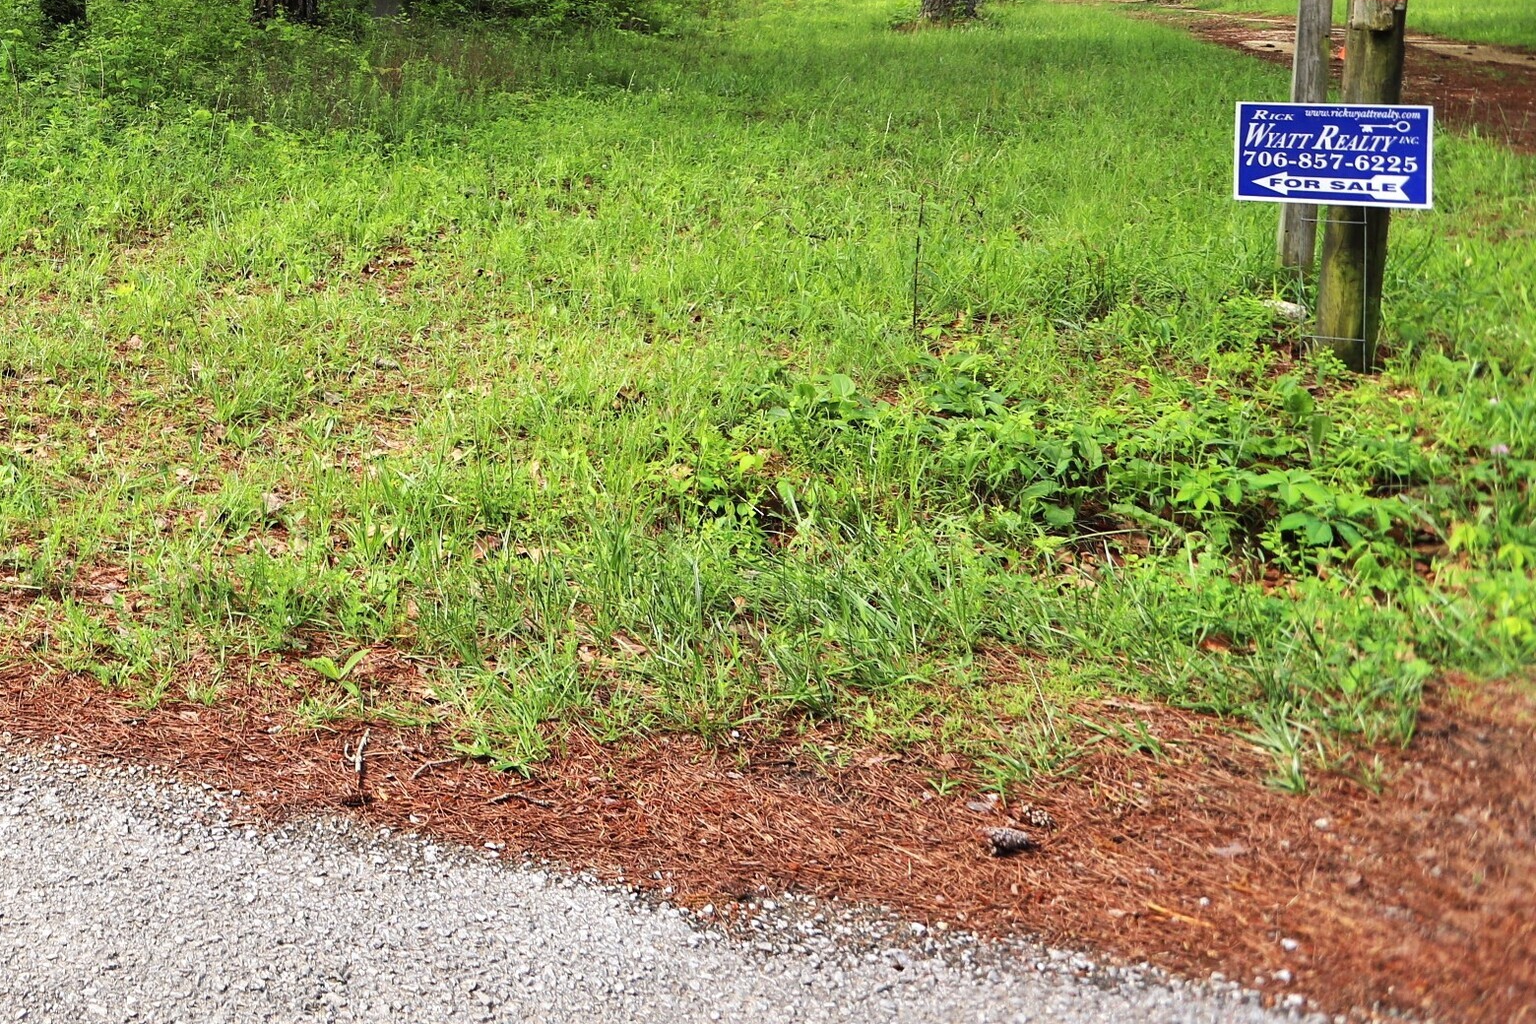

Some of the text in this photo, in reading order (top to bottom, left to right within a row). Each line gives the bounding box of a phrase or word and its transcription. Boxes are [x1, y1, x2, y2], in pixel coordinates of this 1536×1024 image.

[1305, 108, 1421, 121] www.rickwyattrealty.com
[1243, 150, 1418, 173] 706-857-6225
[1270, 179, 1397, 192] FOR SALE
